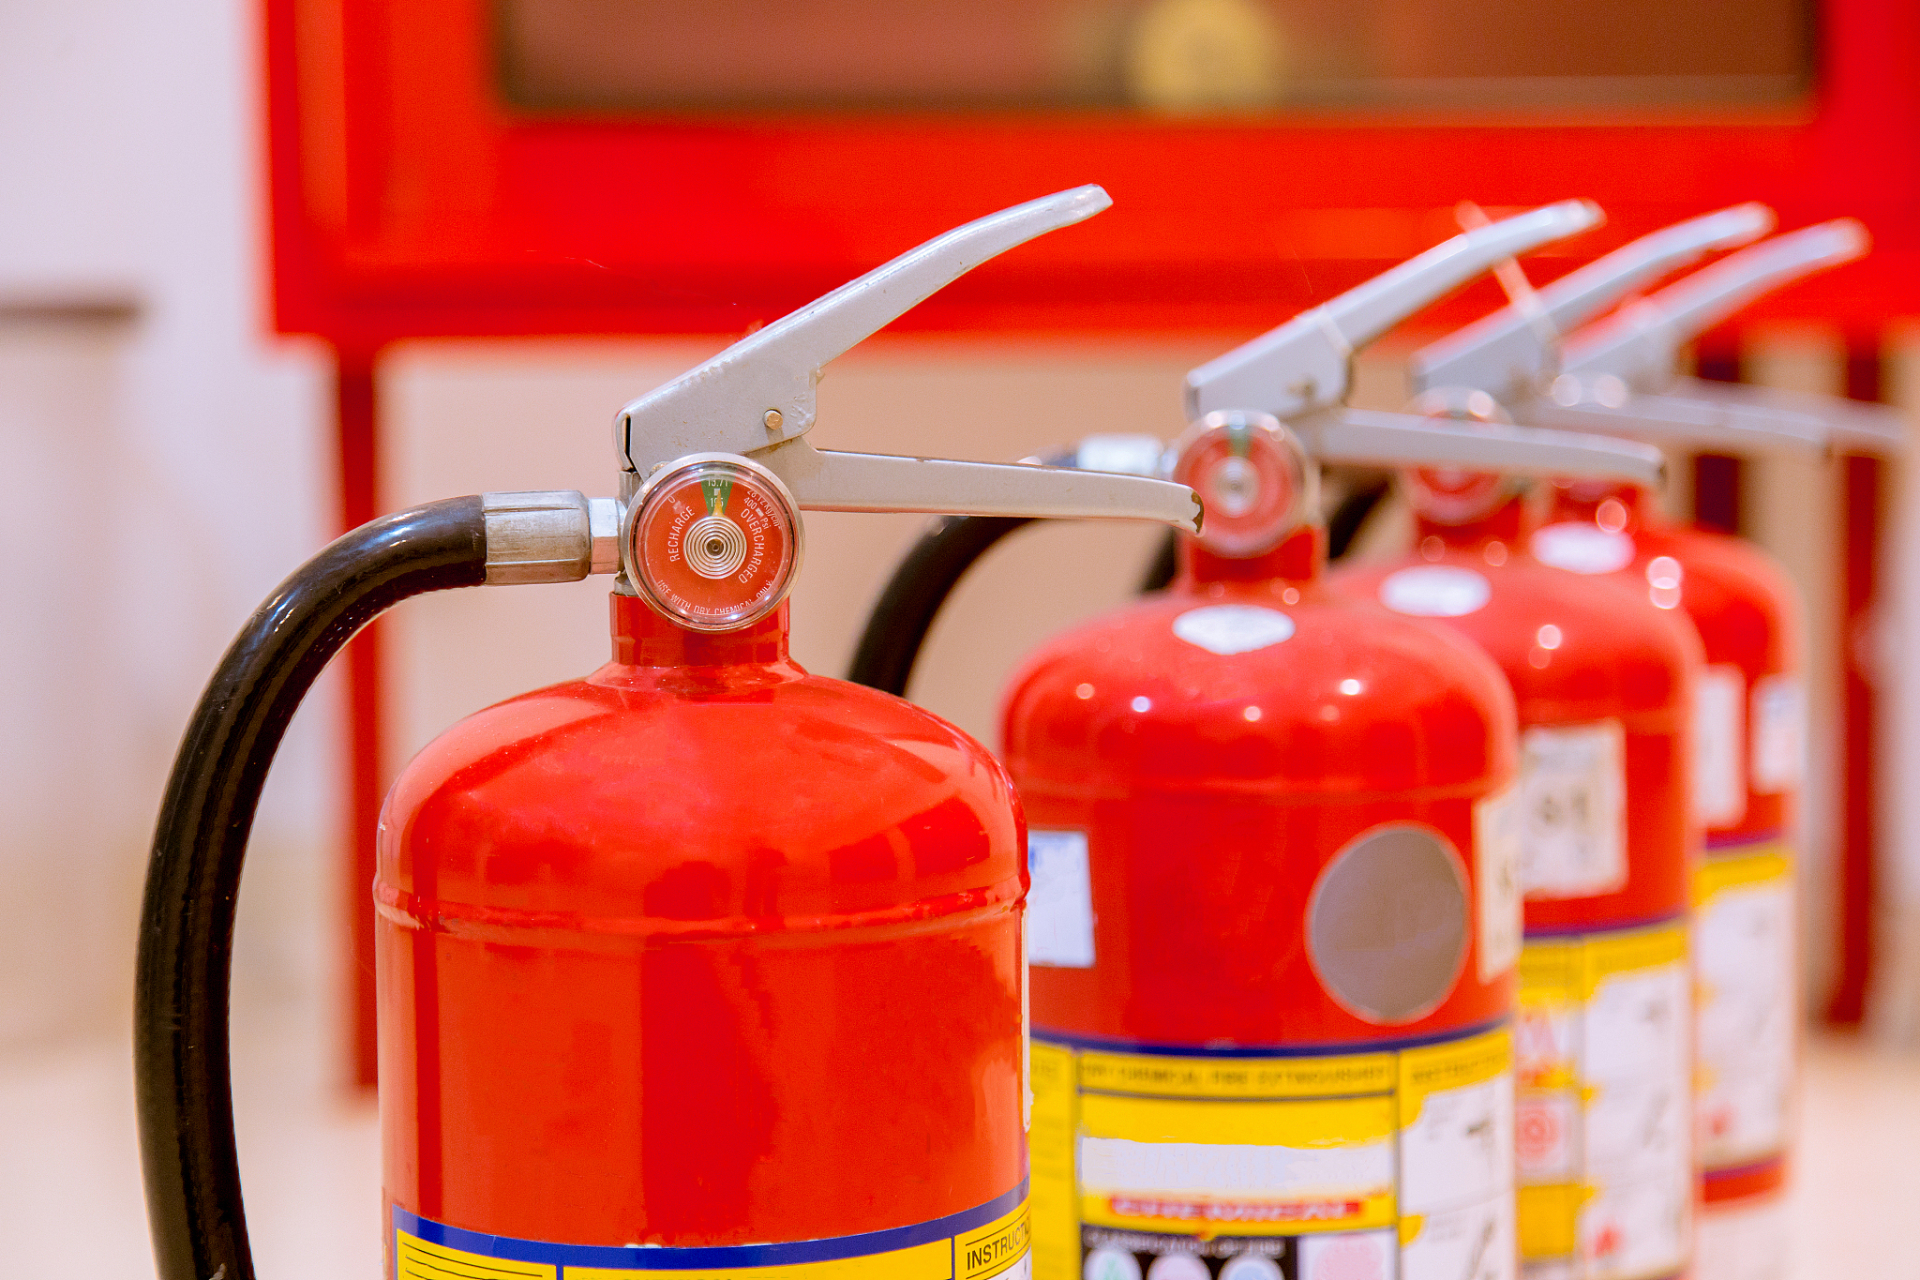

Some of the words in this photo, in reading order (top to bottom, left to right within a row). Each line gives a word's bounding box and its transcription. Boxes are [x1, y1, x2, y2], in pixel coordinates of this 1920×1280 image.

[743, 497, 756, 510] 400
[668, 505, 695, 562] RECHARGE
[738, 508, 765, 584] OVERCHARGED
[657, 579, 672, 595] USE
[671, 594, 691, 609] WITH
[693, 605, 711, 615] DRY
